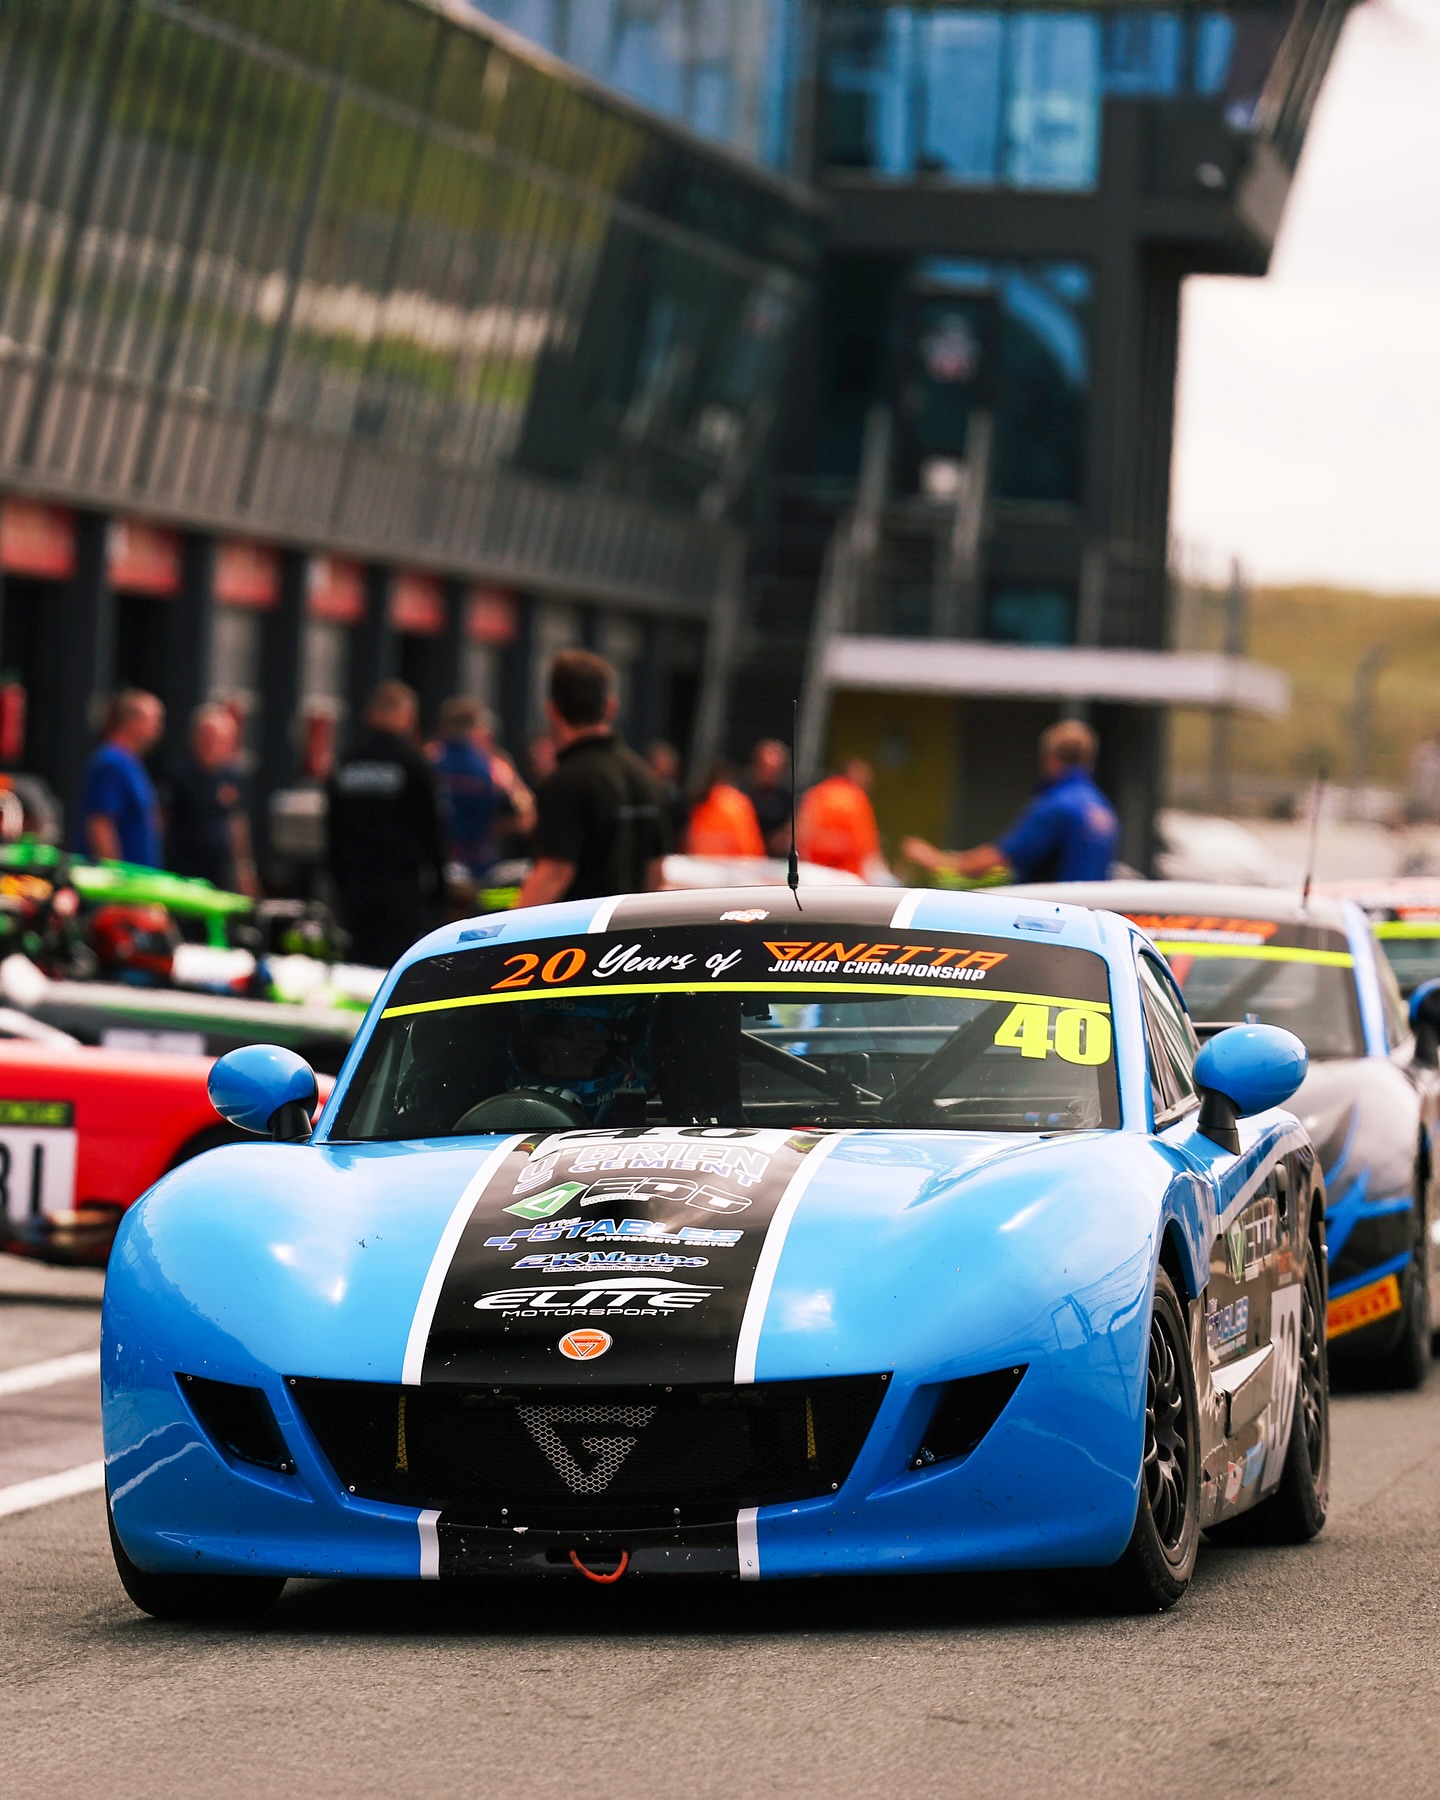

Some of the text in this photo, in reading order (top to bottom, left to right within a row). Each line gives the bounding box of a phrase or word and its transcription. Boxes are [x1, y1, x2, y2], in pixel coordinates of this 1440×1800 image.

[490, 941, 1009, 990] 20 Years of GINETTA
[767, 960, 987, 982] JUNIOR CHAMPIONSHIP
[994, 1003, 1112, 1066] 40
[568, 1158, 762, 1187] CEMENT
[527, 1219, 744, 1243] STABLES
[474, 1290, 712, 1309] ELITE
[501, 1308, 675, 1318] MOTORSPORT
